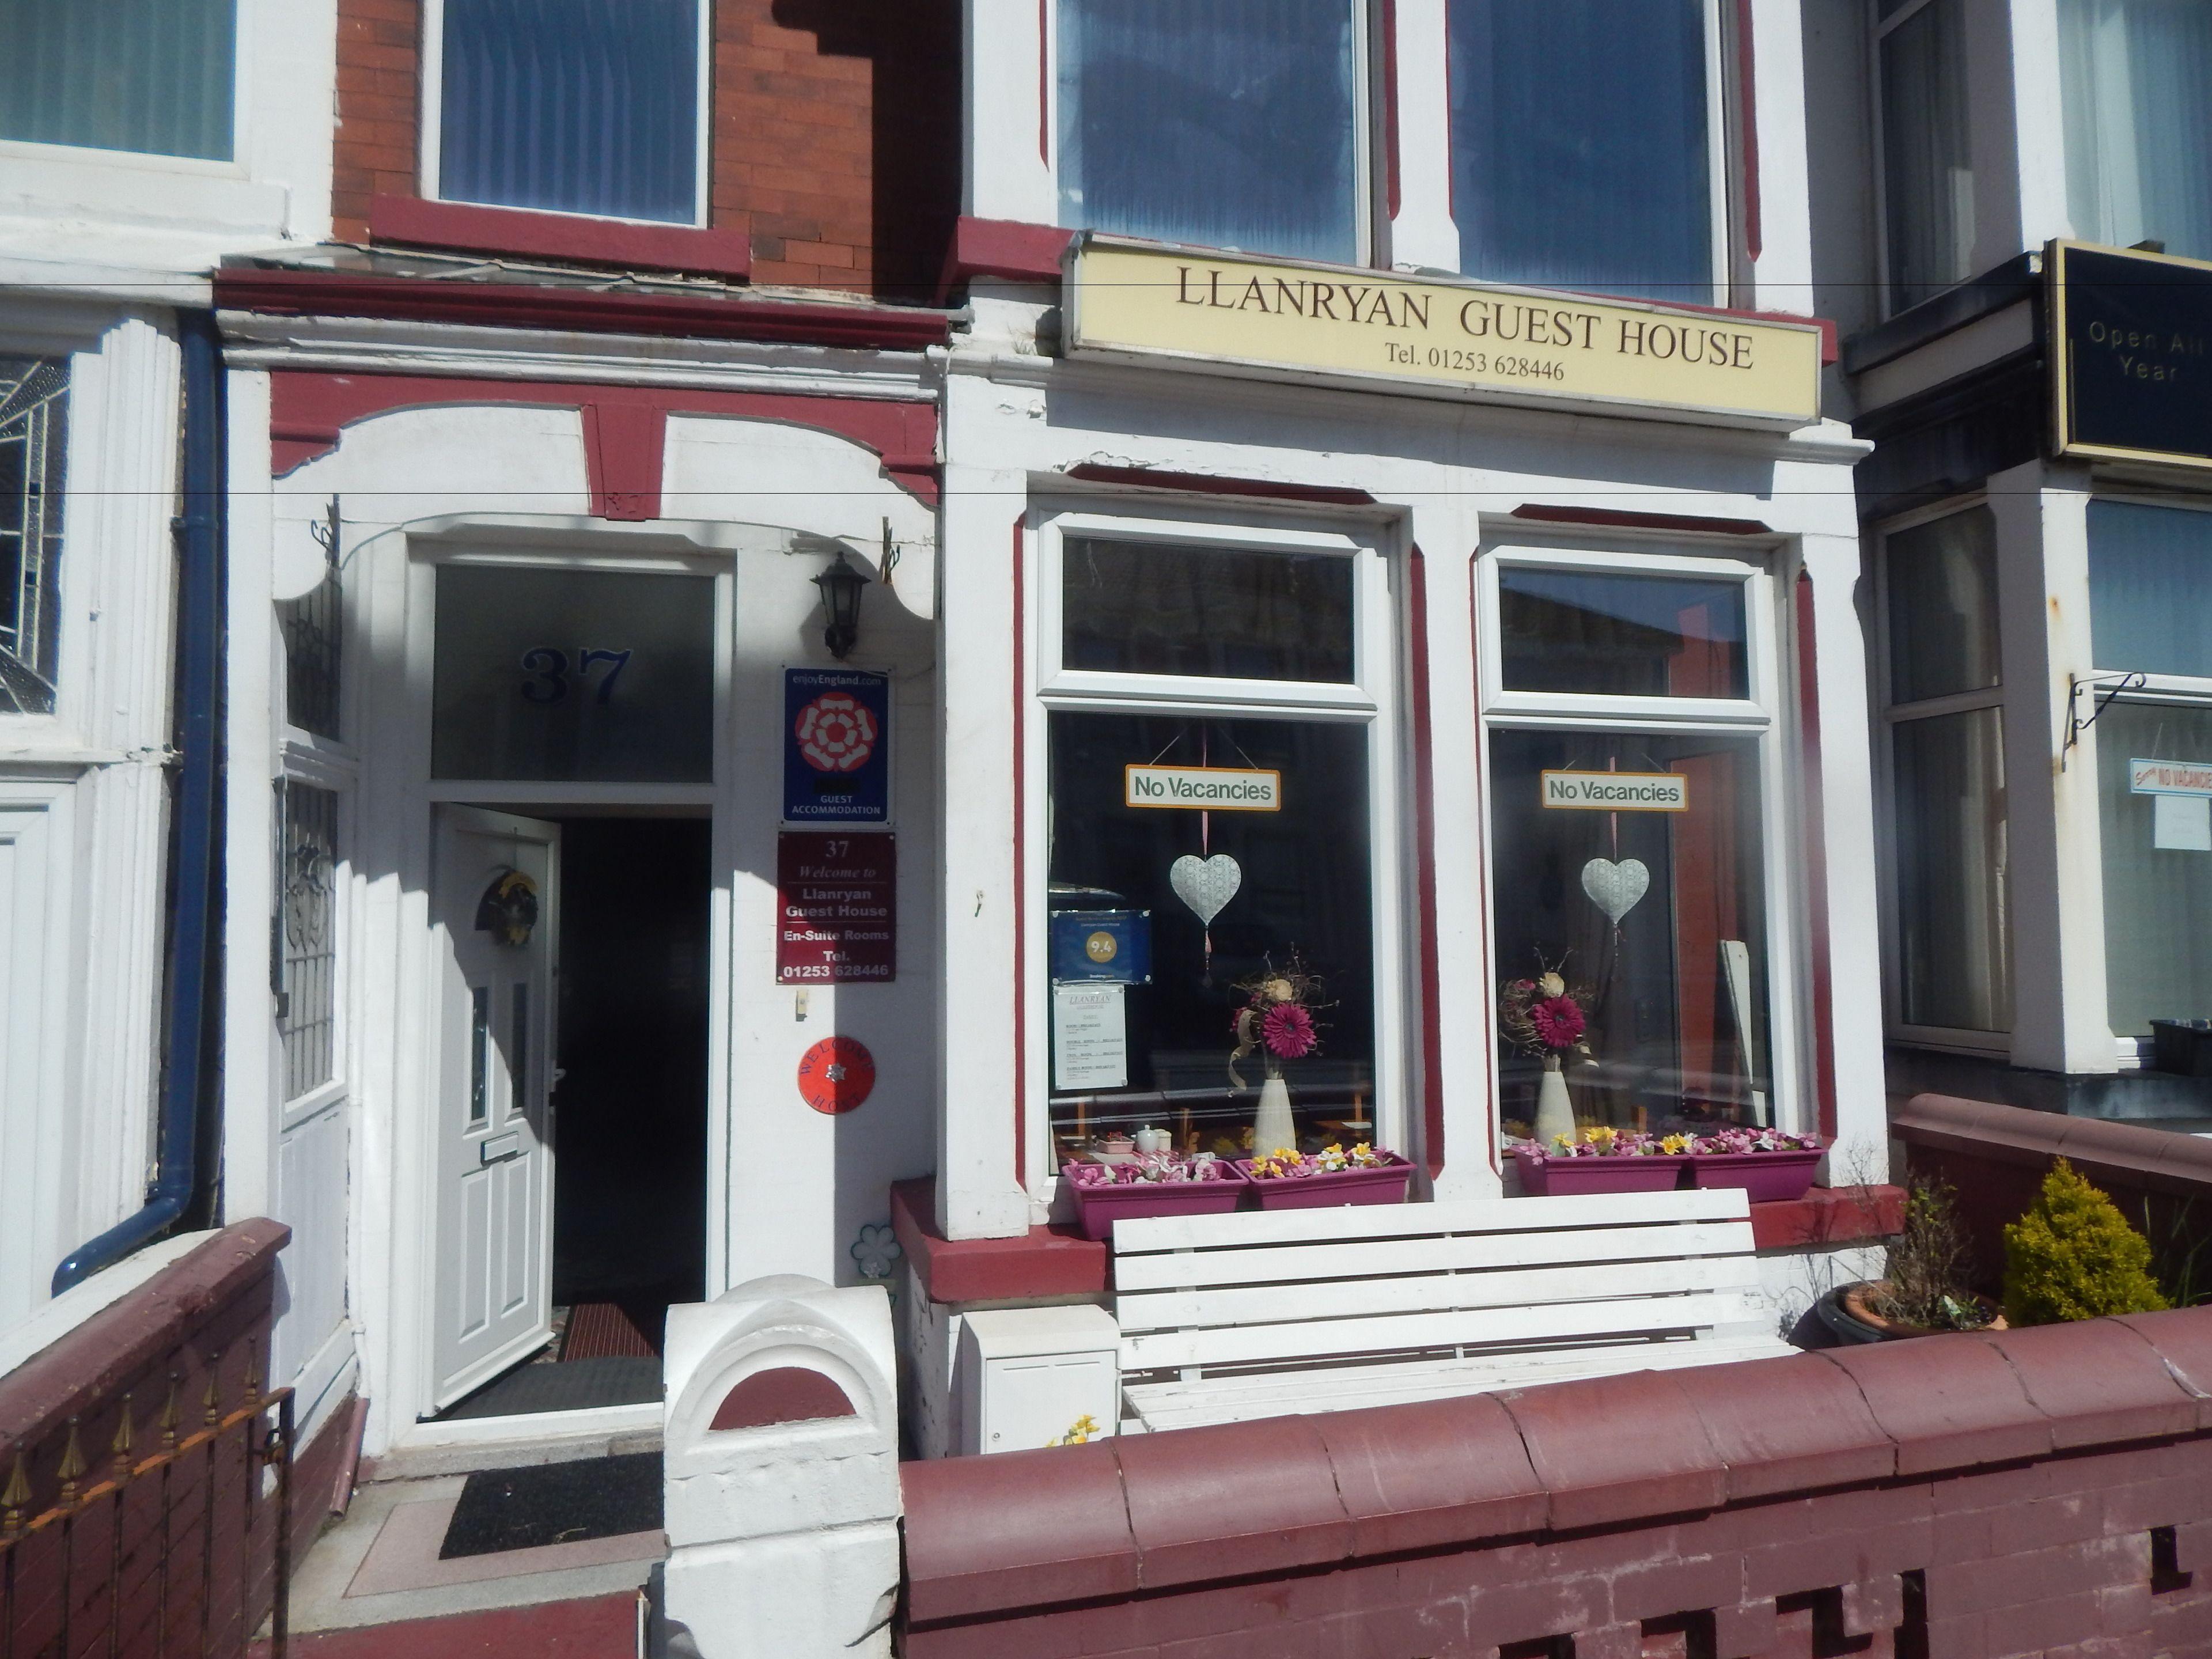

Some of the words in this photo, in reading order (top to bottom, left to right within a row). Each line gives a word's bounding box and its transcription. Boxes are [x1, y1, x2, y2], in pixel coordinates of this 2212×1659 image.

[1176, 267, 1433, 330] LLANRYAN
[1460, 298, 1601, 350] GUEST
[1617, 319, 1755, 370] HOUSE
[2089, 321, 2157, 349] Open
[2171, 333, 2203, 355] All
[1384, 342, 1422, 366] Tel.
[1428, 347, 1487, 373] 01253
[1494, 355, 1565, 381] 628446
[2120, 355, 2178, 381] Year
[521, 646, 633, 704] 37
[792, 674, 881, 687] enjoyEngland.com
[2158, 768, 2171, 786] NO
[2173, 770, 2212, 789] VACANCIE
[1135, 776, 1165, 797] No
[1168, 777, 1272, 801] Vacancies
[1550, 780, 1578, 800] No
[1580, 781, 1680, 802] Vacancies
[820, 796, 853, 804] GUEST
[791, 805, 881, 815] ACCOMMODATION
[825, 840, 849, 858] 37
[799, 866, 861, 878] Welcome
[863, 866, 876, 878] to
[802, 888, 872, 902] Llanryan
[786, 906, 833, 918] Guest
[838, 906, 888, 917] House
[783, 930, 840, 941] En-Suite
[844, 930, 890, 941] Rooms
[1091, 940, 1112, 953] 9.4
[823, 950, 851, 962] Tel.
[783, 966, 830, 978] 01253
[835, 965, 889, 976] 628446
[1069, 995, 1112, 1004] LLANRYAN
